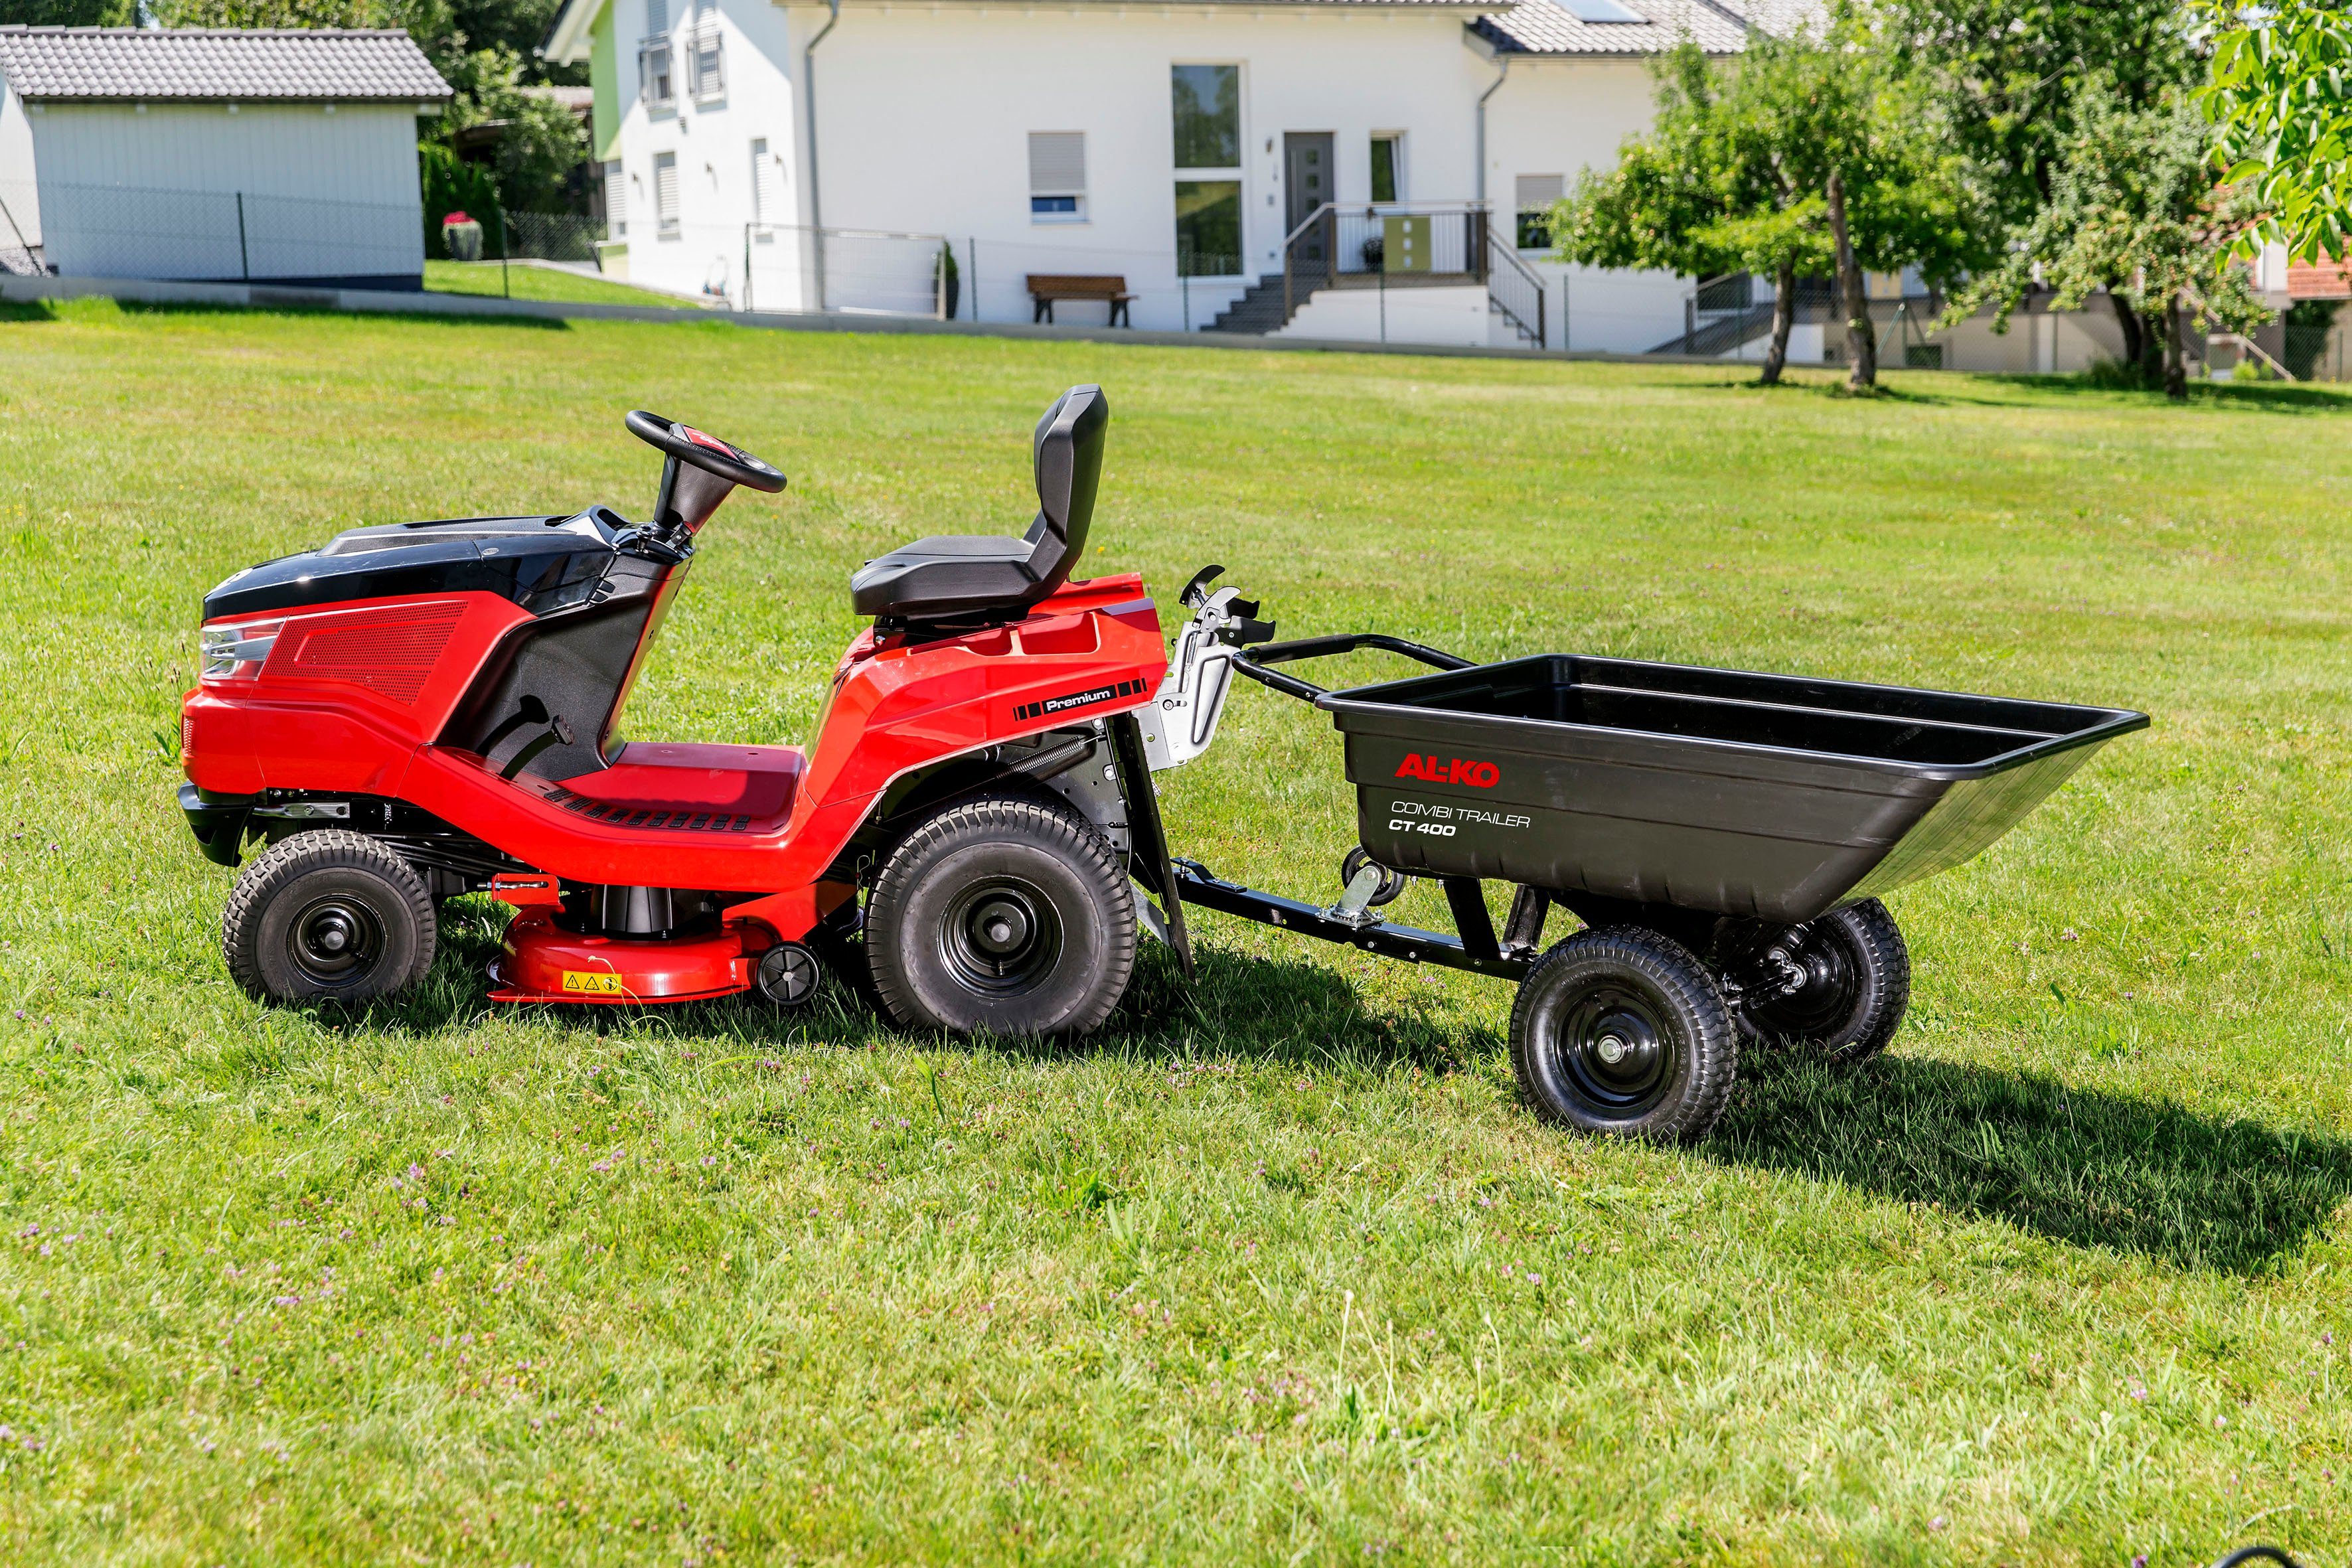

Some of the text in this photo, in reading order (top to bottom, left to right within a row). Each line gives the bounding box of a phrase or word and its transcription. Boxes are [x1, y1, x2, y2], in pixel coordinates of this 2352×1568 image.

[1046, 690, 1111, 711] Premium
[1395, 753, 1500, 788] AL-KO
[1391, 801, 1531, 828] COMBI TRAILER
[1388, 819, 1456, 836] CT 400
